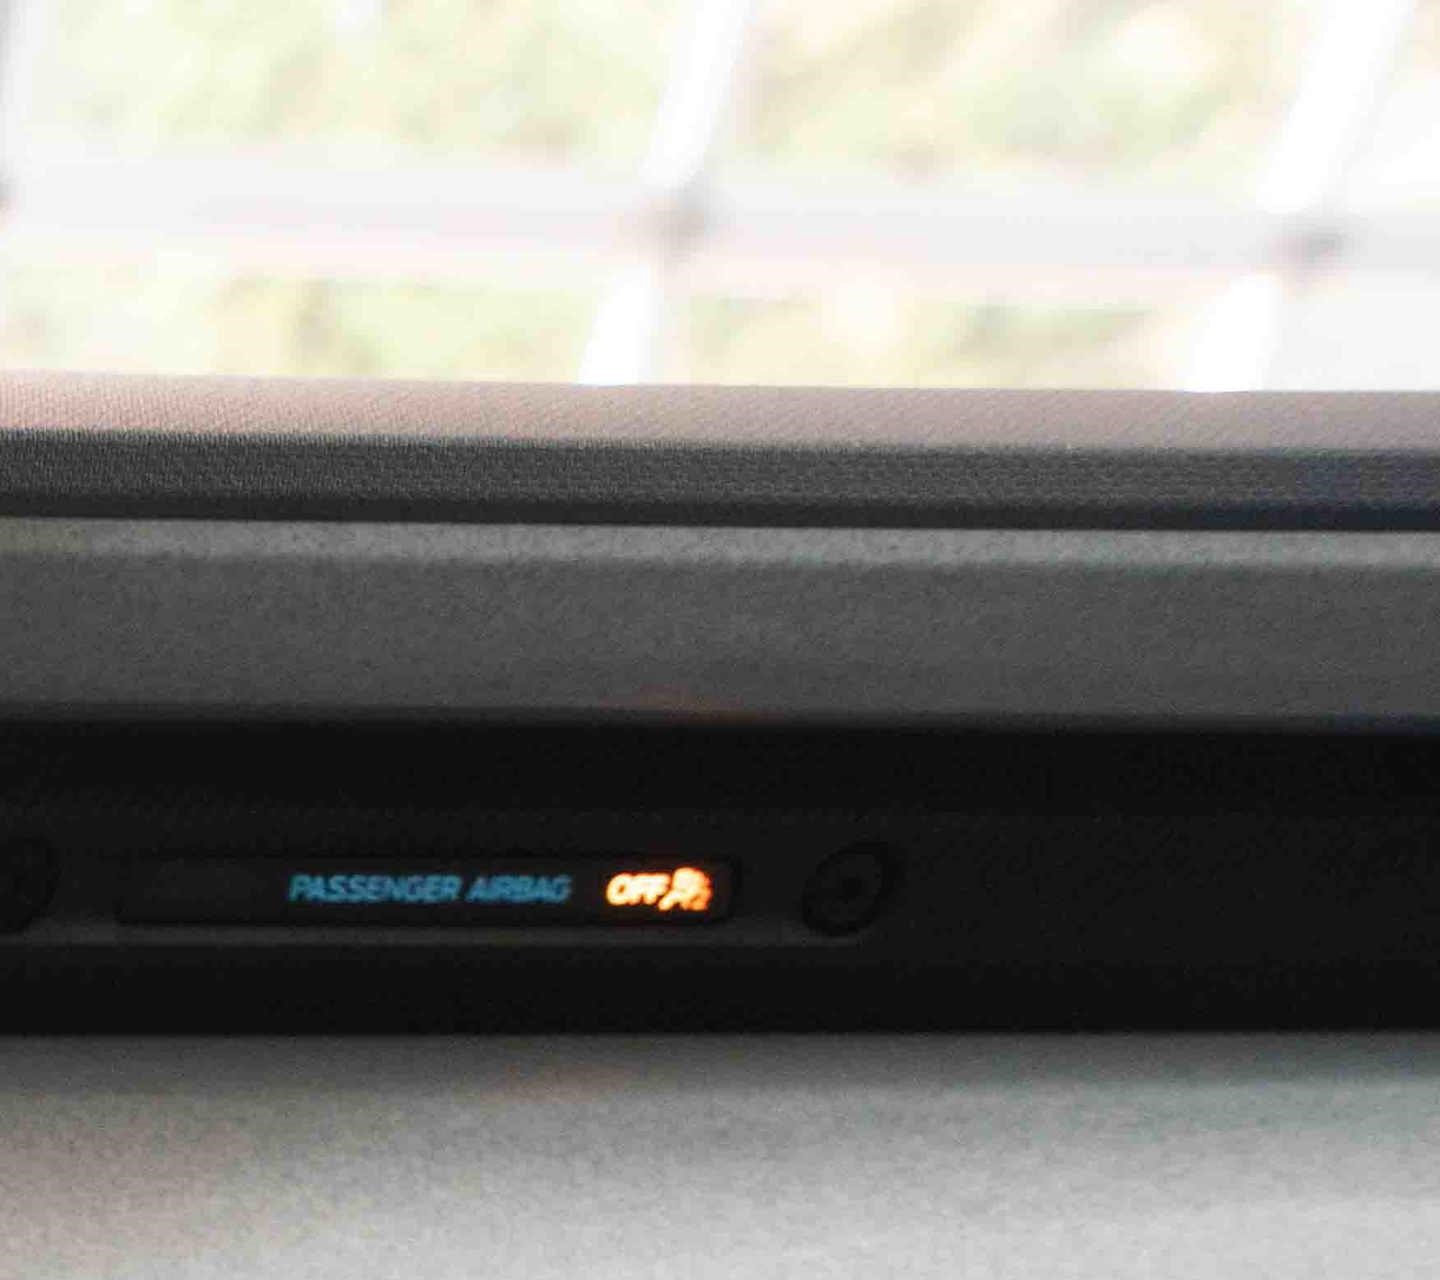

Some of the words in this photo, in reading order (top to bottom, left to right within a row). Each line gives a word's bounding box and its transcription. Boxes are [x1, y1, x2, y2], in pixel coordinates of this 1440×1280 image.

[288, 873, 459, 903] PASSENGER
[465, 874, 572, 903] AIRBAG
[605, 873, 670, 906] OFF
